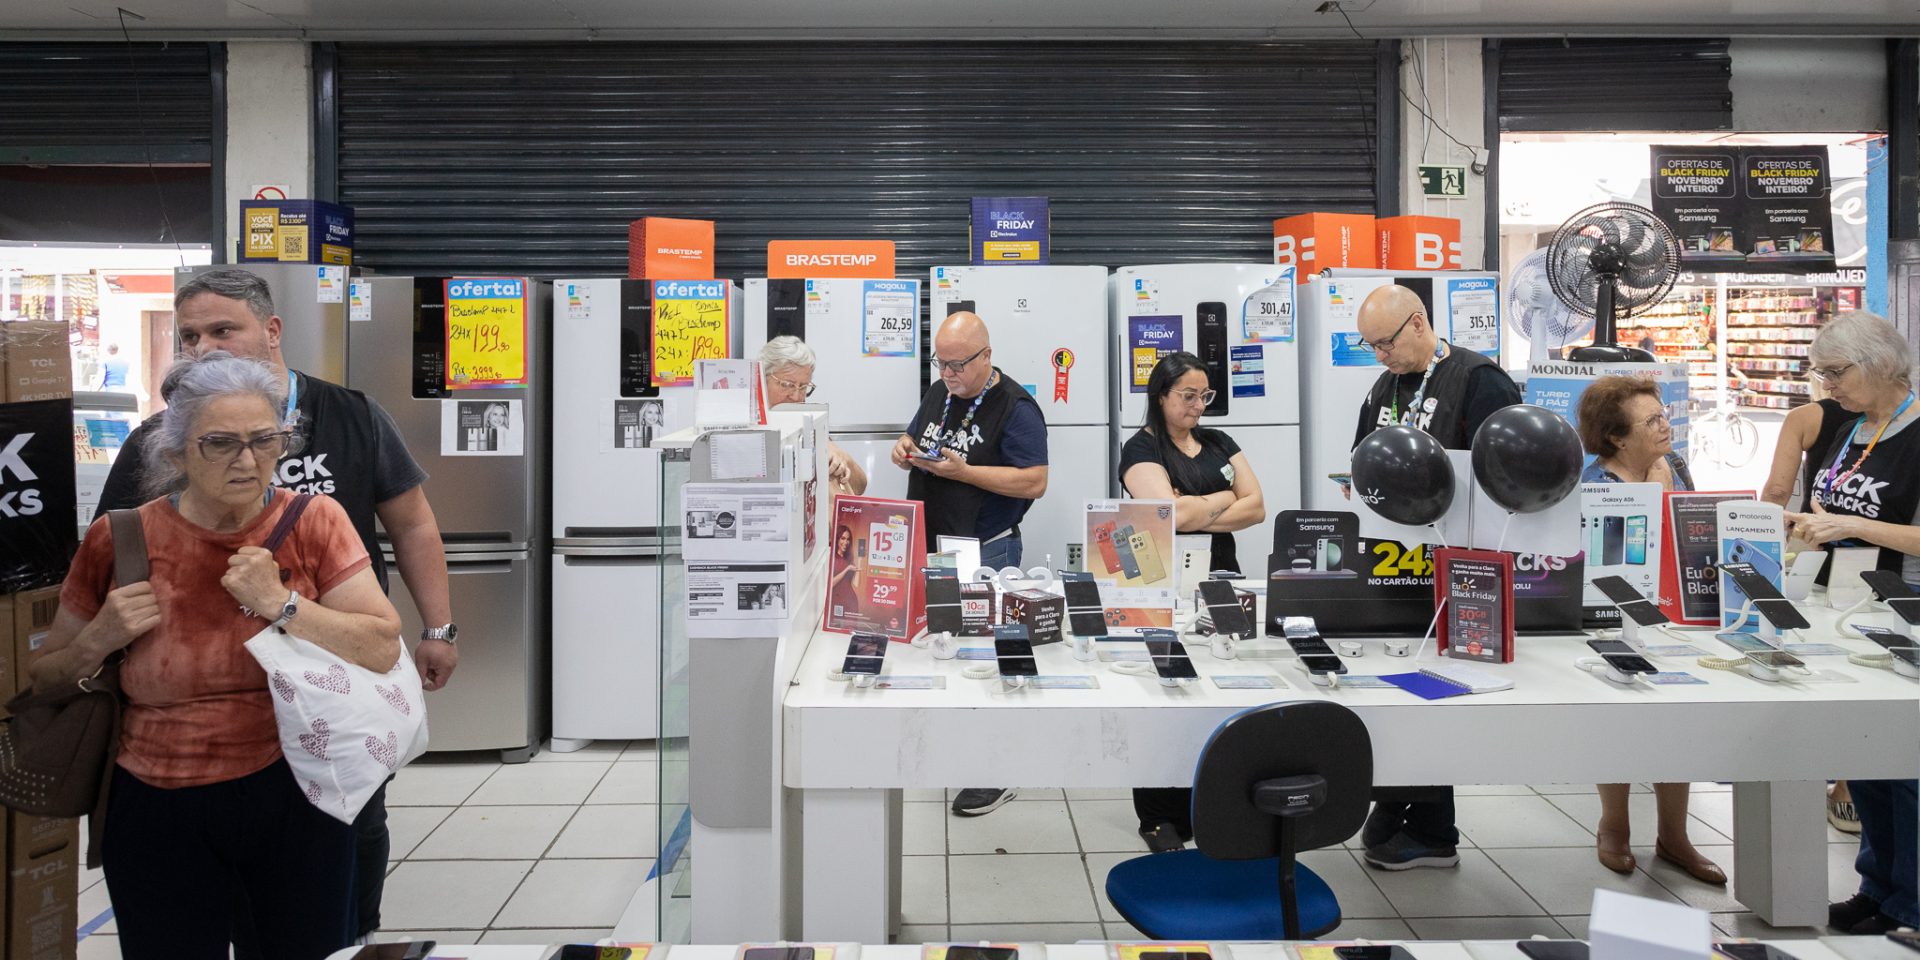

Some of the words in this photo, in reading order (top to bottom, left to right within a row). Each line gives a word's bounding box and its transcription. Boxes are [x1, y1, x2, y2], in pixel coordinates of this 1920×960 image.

[1668, 160, 1708, 168] OFERTAS
[1710, 160, 1722, 168] DE
[1758, 161, 1798, 169] OFERTAS
[991, 212, 1024, 220] BLACK
[1679, 215, 1717, 223] Samsung
[329, 224, 349, 236] FRIDAY
[997, 220, 1034, 229] FRIDAY
[251, 234, 273, 245] PIX
[786, 255, 876, 266] BRASTEMP
[450, 281, 521, 296] oferta!
[656, 283, 723, 296] oferta!
[1260, 302, 1291, 317] 301,47
[881, 318, 912, 333] 262,59
[1470, 316, 1496, 330] 315,12
[29, 358, 56, 367] TCL
[1531, 365, 1596, 376] MONDIAL
[1546, 398, 1568, 406] PÁS
[1686, 567, 1702, 579] Eu
[1383, 576, 1418, 585] CARTÃO
[1452, 590, 1470, 598] Black
[1472, 592, 1496, 602] Friday
[1459, 609, 1486, 620] 30GB
[29, 858, 68, 880] TCL
